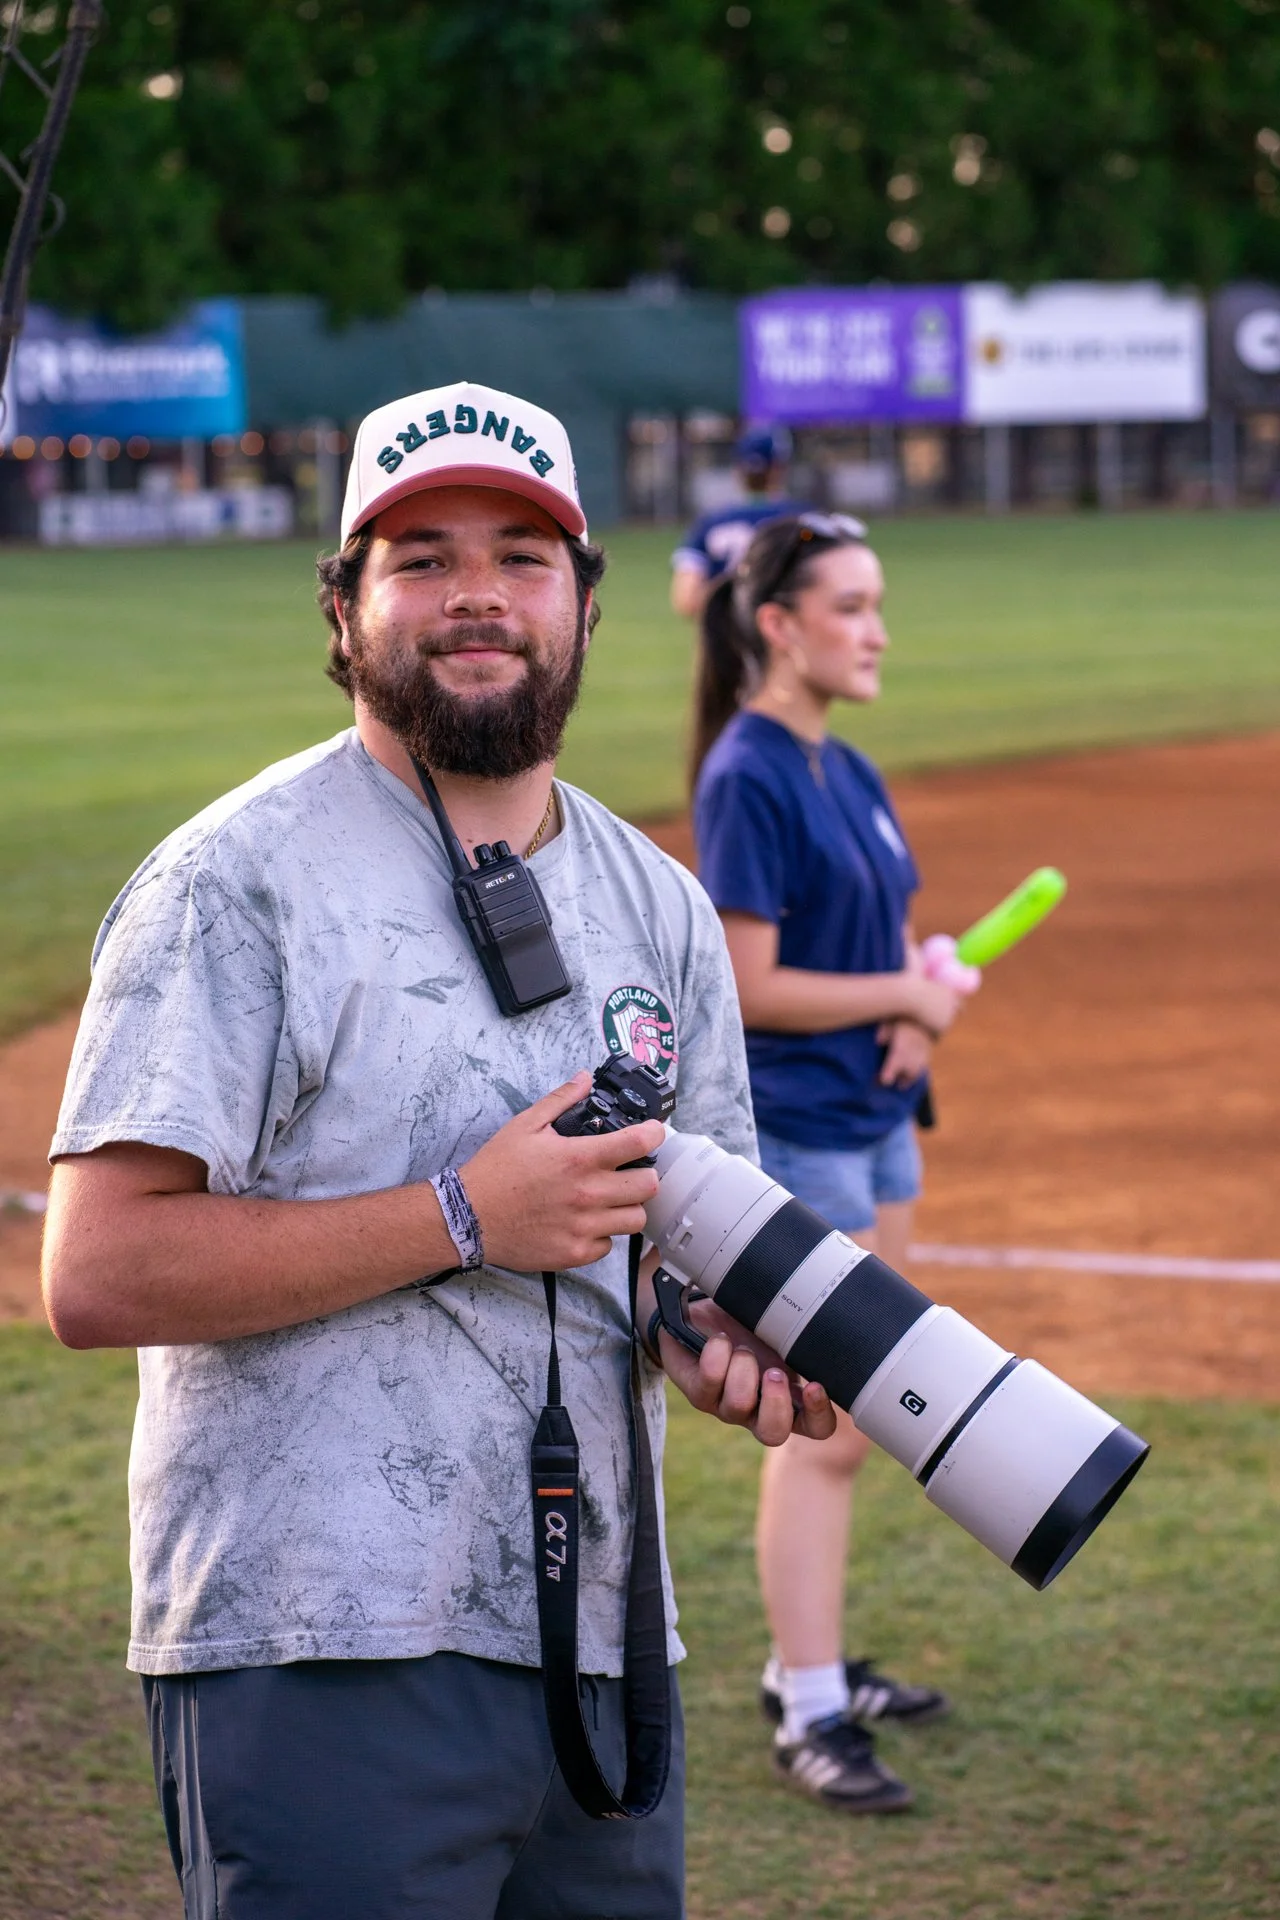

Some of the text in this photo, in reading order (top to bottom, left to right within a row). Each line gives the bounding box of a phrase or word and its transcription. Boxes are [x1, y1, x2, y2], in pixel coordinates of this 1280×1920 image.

[377, 404, 555, 478] BANGERS
[607, 988, 658, 1011] PORTLAND
[661, 1035, 673, 1046] FC
[661, 1099, 674, 1111] SONY
[780, 1294, 803, 1312] SONY
[904, 1395, 923, 1412] G
